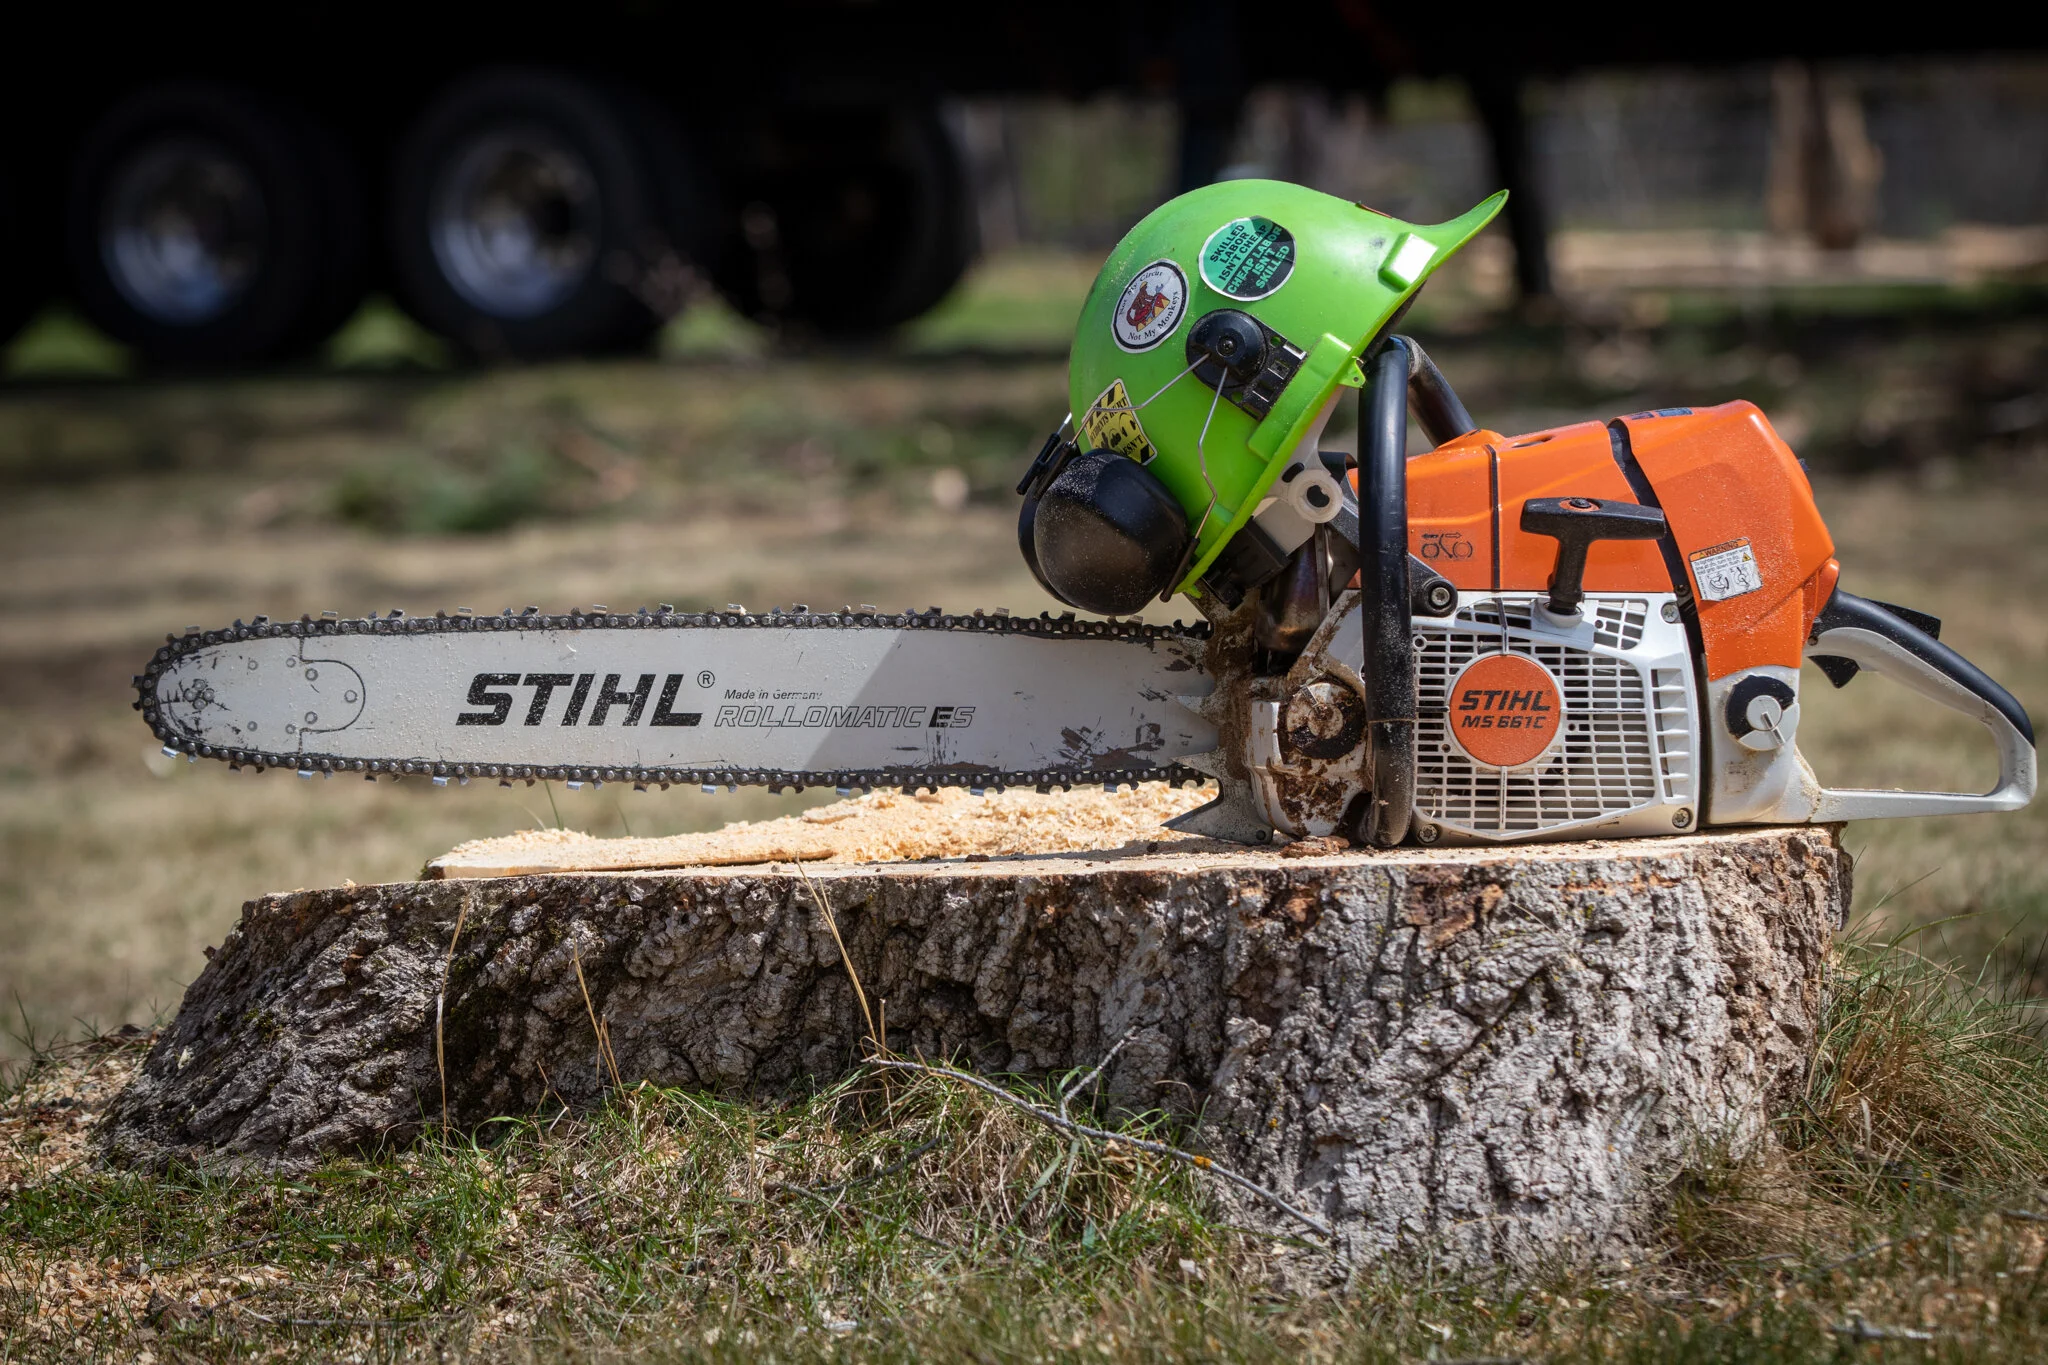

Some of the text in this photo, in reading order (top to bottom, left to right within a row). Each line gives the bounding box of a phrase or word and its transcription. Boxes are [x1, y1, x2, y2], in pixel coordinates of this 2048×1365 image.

[1210, 224, 1245, 262] SKILLED
[1218, 224, 1267, 281] ISN'T CHEAP
[1220, 232, 1250, 264] LABOR
[1227, 226, 1283, 294] CHEAP LABOR
[1252, 248, 1276, 276] ISN'T
[1256, 246, 1290, 288] SKILLED
[1140, 271, 1163, 282] Circus
[1128, 291, 1180, 340] Not My Monkeys
[1704, 541, 1739, 556] WARNING
[456, 673, 703, 726] STIHL
[724, 690, 755, 700] Made
[758, 690, 769, 700] in
[1458, 690, 1551, 712] STIHL
[714, 706, 976, 728] ROLLOMATIC ES
[1462, 716, 1547, 729] MS 661C
